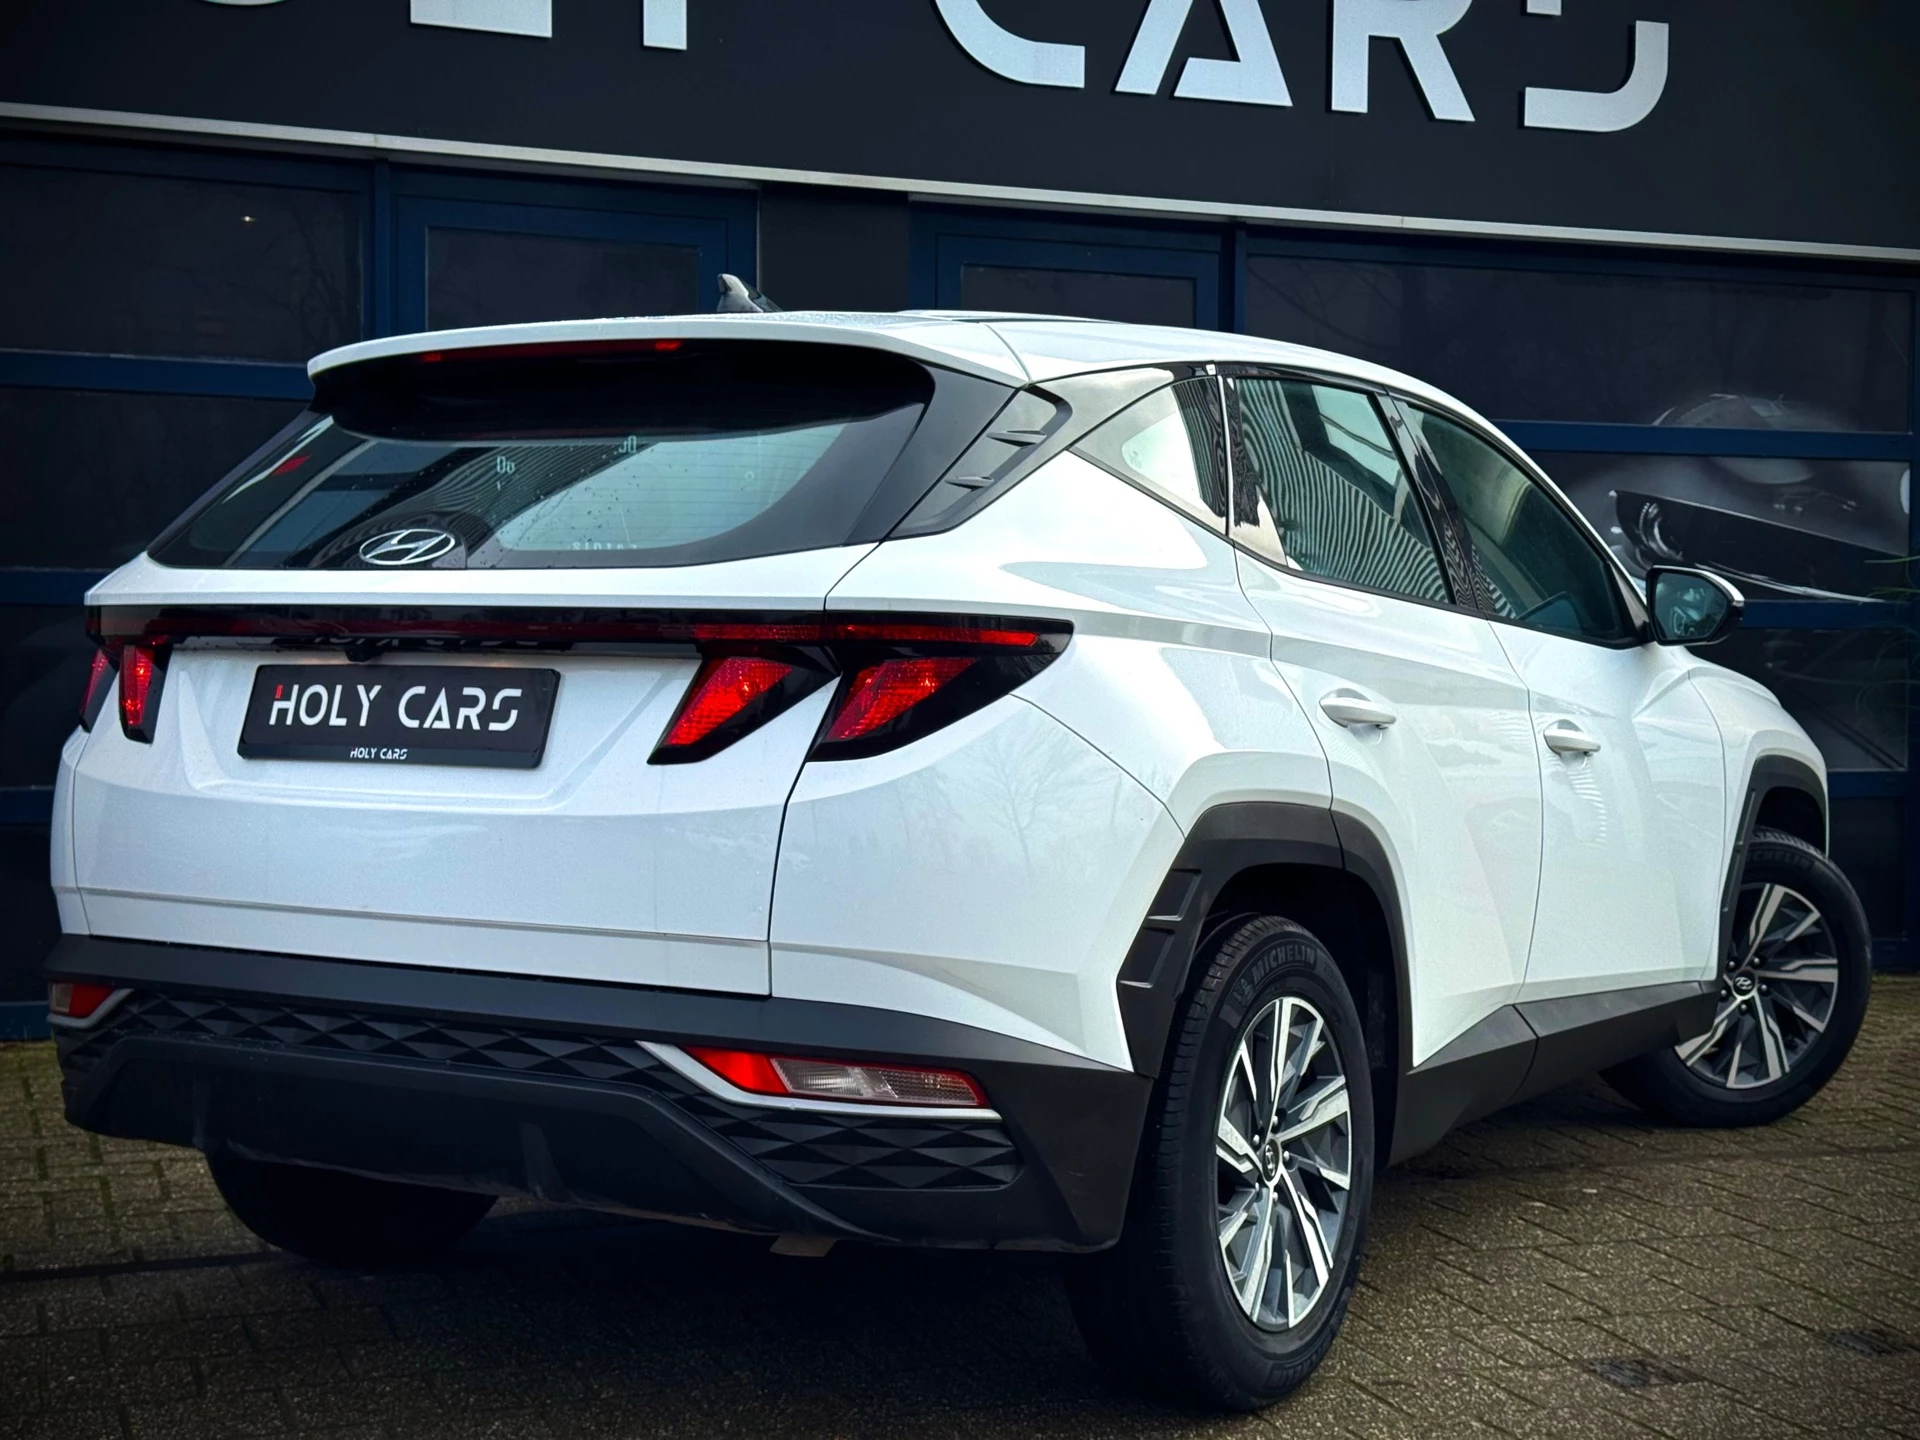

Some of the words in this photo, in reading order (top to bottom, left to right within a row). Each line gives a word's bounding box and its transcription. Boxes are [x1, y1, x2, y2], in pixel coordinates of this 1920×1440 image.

[269, 684, 382, 727] HOLY
[398, 685, 522, 731] CARS
[350, 747, 377, 759] HOLY
[380, 748, 408, 760] CARS
[1251, 944, 1315, 985] MICHELIN
